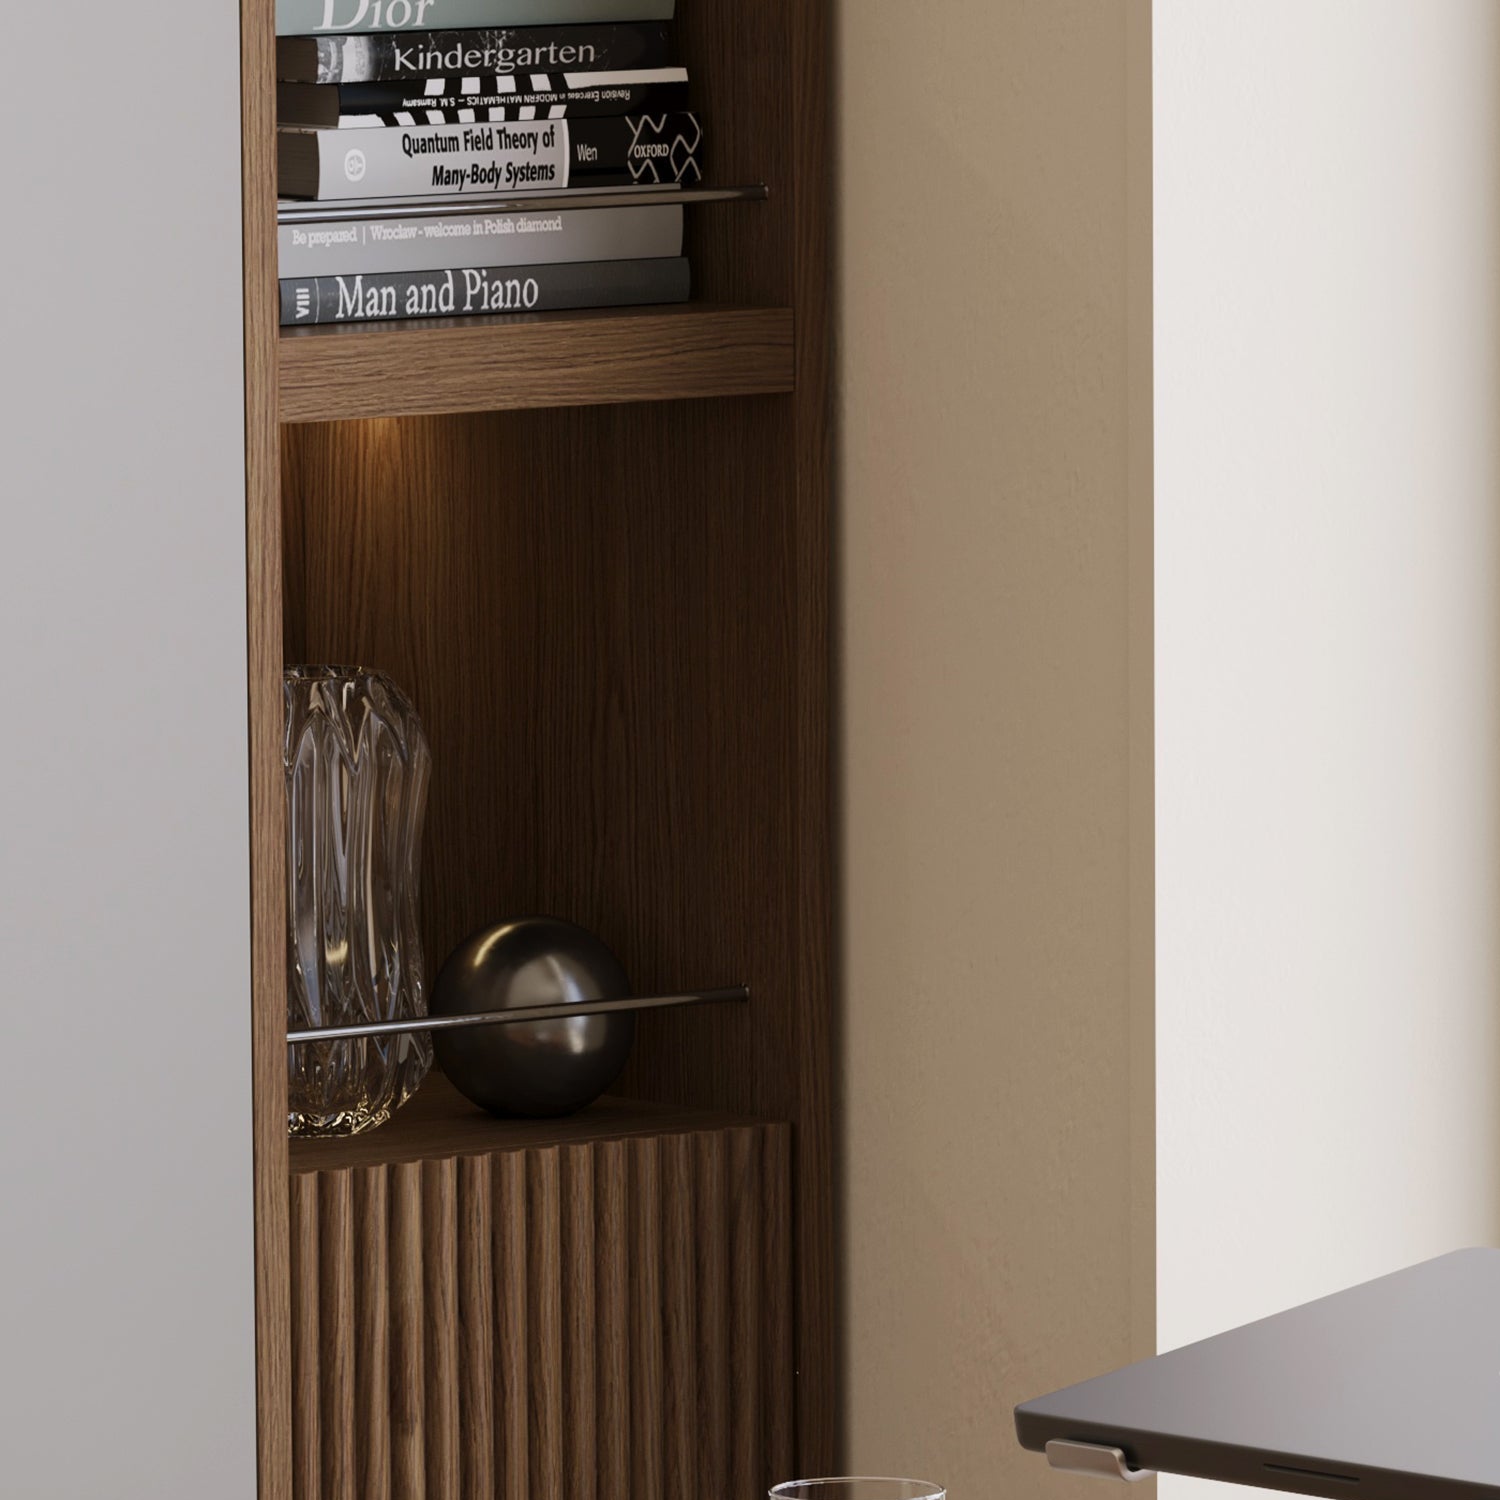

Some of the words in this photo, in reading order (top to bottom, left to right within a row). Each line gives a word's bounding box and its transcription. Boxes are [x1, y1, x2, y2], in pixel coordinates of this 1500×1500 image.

[313, 0, 434, 31] Dior
[394, 43, 595, 73] Kindergarten
[402, 133, 459, 158] Quantum
[463, 128, 493, 152] Field
[496, 126, 538, 155] Theory
[543, 124, 555, 149] of
[576, 143, 598, 161] Wen
[633, 143, 669, 158] OXFORD
[431, 160, 502, 191] Many-Body
[505, 161, 555, 188] Systems
[292, 229, 306, 245] Be
[308, 226, 357, 248] prepared
[423, 221, 471, 238] welcome
[473, 219, 483, 235] in
[484, 218, 515, 234] Polish
[516, 215, 562, 233] diamond
[295, 288, 310, 319] VIII
[335, 275, 396, 319] Man
[406, 270, 455, 315] and
[462, 268, 539, 309] Piano
